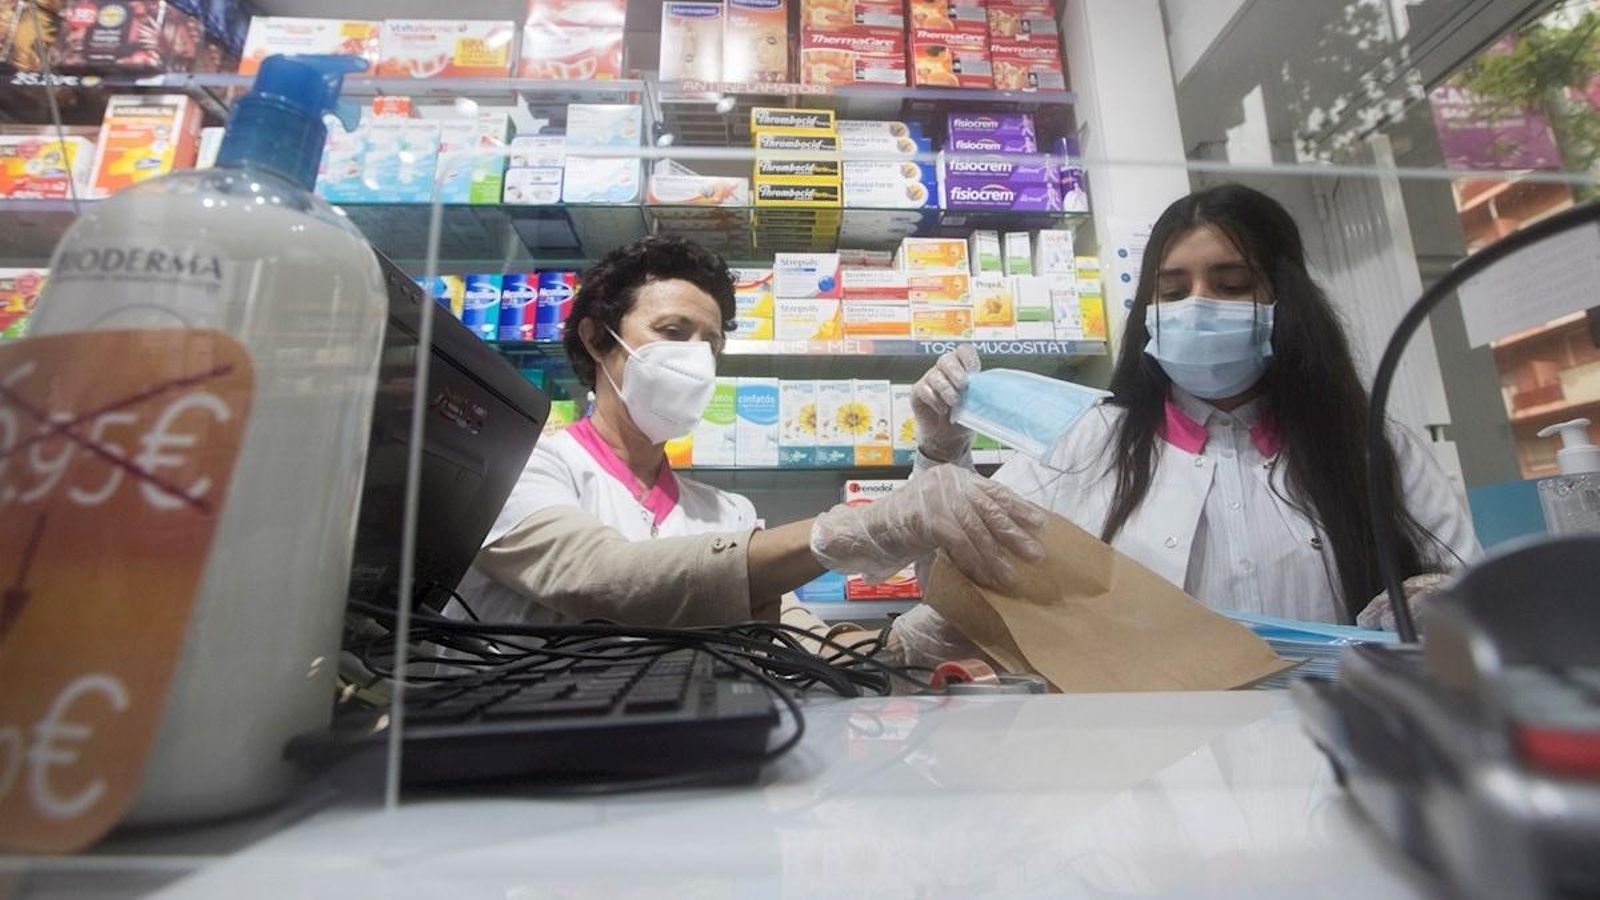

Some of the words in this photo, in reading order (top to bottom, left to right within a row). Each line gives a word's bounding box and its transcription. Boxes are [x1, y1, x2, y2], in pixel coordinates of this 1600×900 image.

[811, 33, 896, 49] ThermaCare
[917, 29, 985, 42] ThermaCare
[990, 44, 1058, 55] ThermaCare
[757, 111, 817, 127] Thrombocid
[953, 117, 999, 130] fisiocrem
[761, 136, 823, 150] Thrombocid
[955, 138, 1002, 151] fisiocrem
[760, 159, 816, 173] Thrombocid
[949, 160, 1012, 172] fisiocrem
[760, 184, 816, 198] Thrombocid
[950, 185, 1015, 201] fisiocrem
[780, 304, 818, 313] Strepsils
[827, 341, 868, 355] MEL
[920, 341, 957, 354] TOS
[971, 341, 1070, 354] MUCOSITAT
[738, 394, 775, 404] cinfatós
